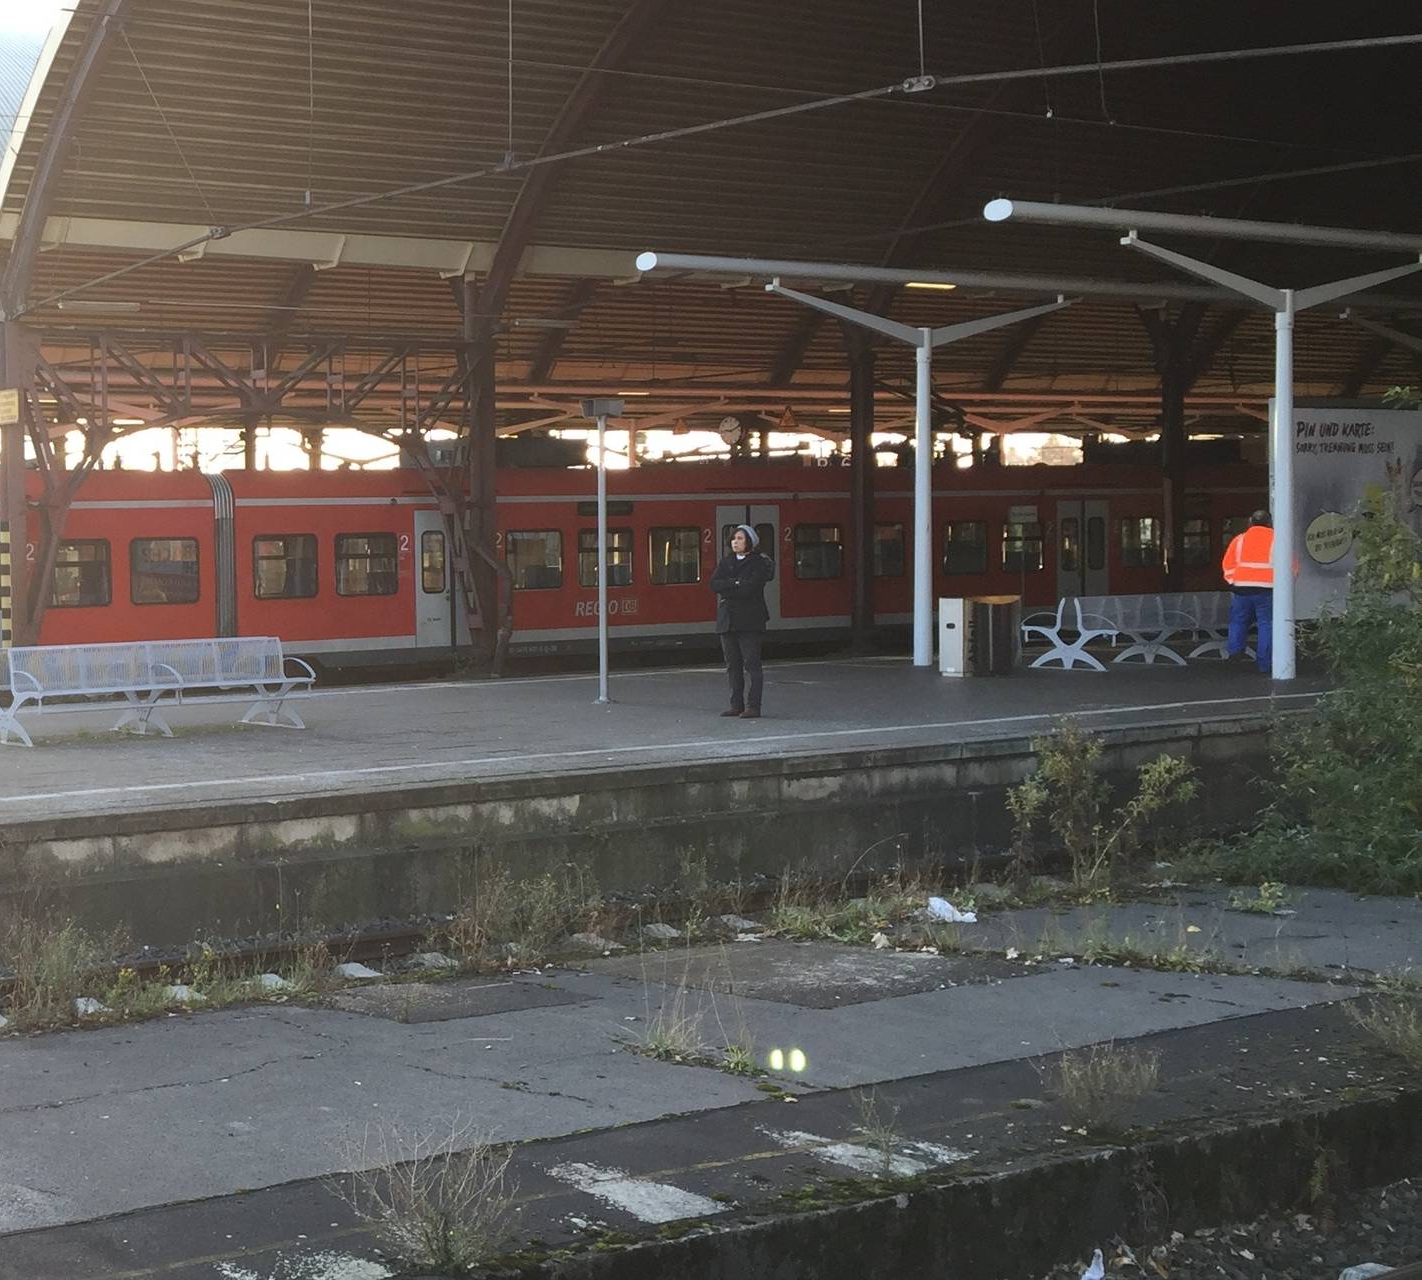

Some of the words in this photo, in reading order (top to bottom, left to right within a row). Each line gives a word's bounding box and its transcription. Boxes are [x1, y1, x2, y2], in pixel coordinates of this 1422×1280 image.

[1296, 421, 1316, 438] PIN
[1319, 422, 1339, 438] UND
[1341, 421, 1375, 438] KARTE:
[400, 534, 409, 551] 2
[704, 528, 712, 543] 2
[784, 526, 792, 542] 2
[25, 543, 35, 561] 2
[575, 599, 619, 617] REGO
